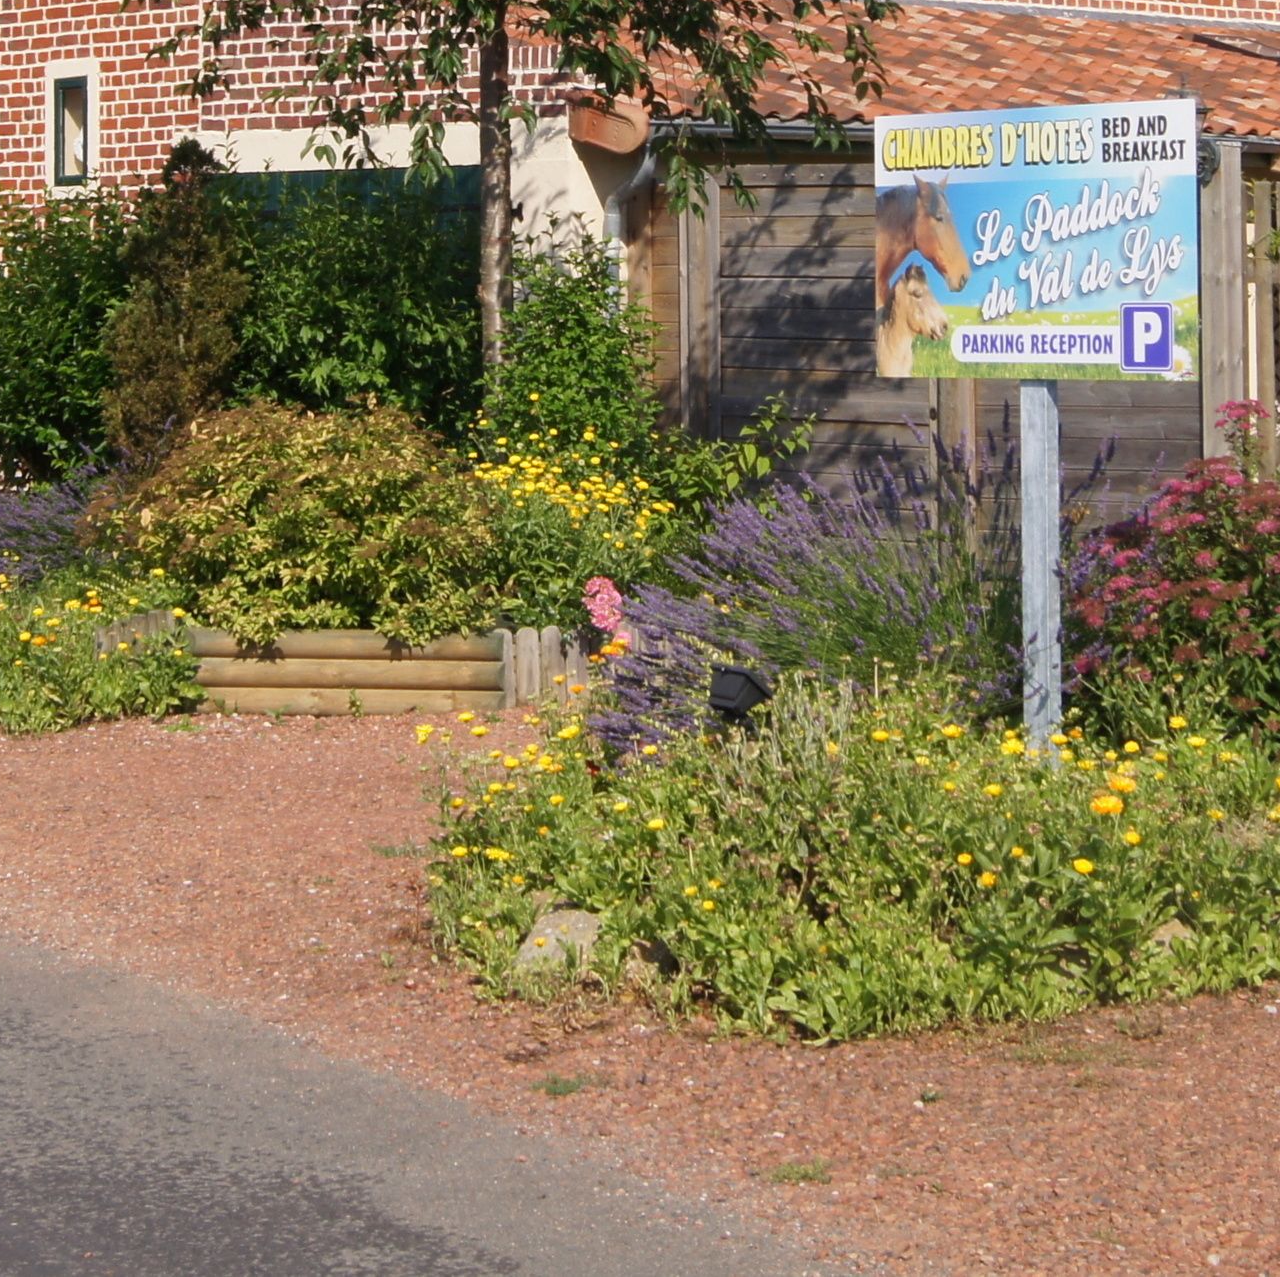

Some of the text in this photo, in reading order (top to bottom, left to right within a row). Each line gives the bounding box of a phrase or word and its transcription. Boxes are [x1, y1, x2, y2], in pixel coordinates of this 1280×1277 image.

[883, 118, 1095, 171] CHAMBRES D'HOTES
[1101, 115, 1167, 139] BED AND
[1101, 139, 1186, 162] BREAKFAST
[972, 166, 1161, 267] Le Paddock
[981, 224, 1184, 321] du Val de Lys
[962, 333, 1114, 355] PARKING RECEPTION
[1132, 311, 1163, 363] P
